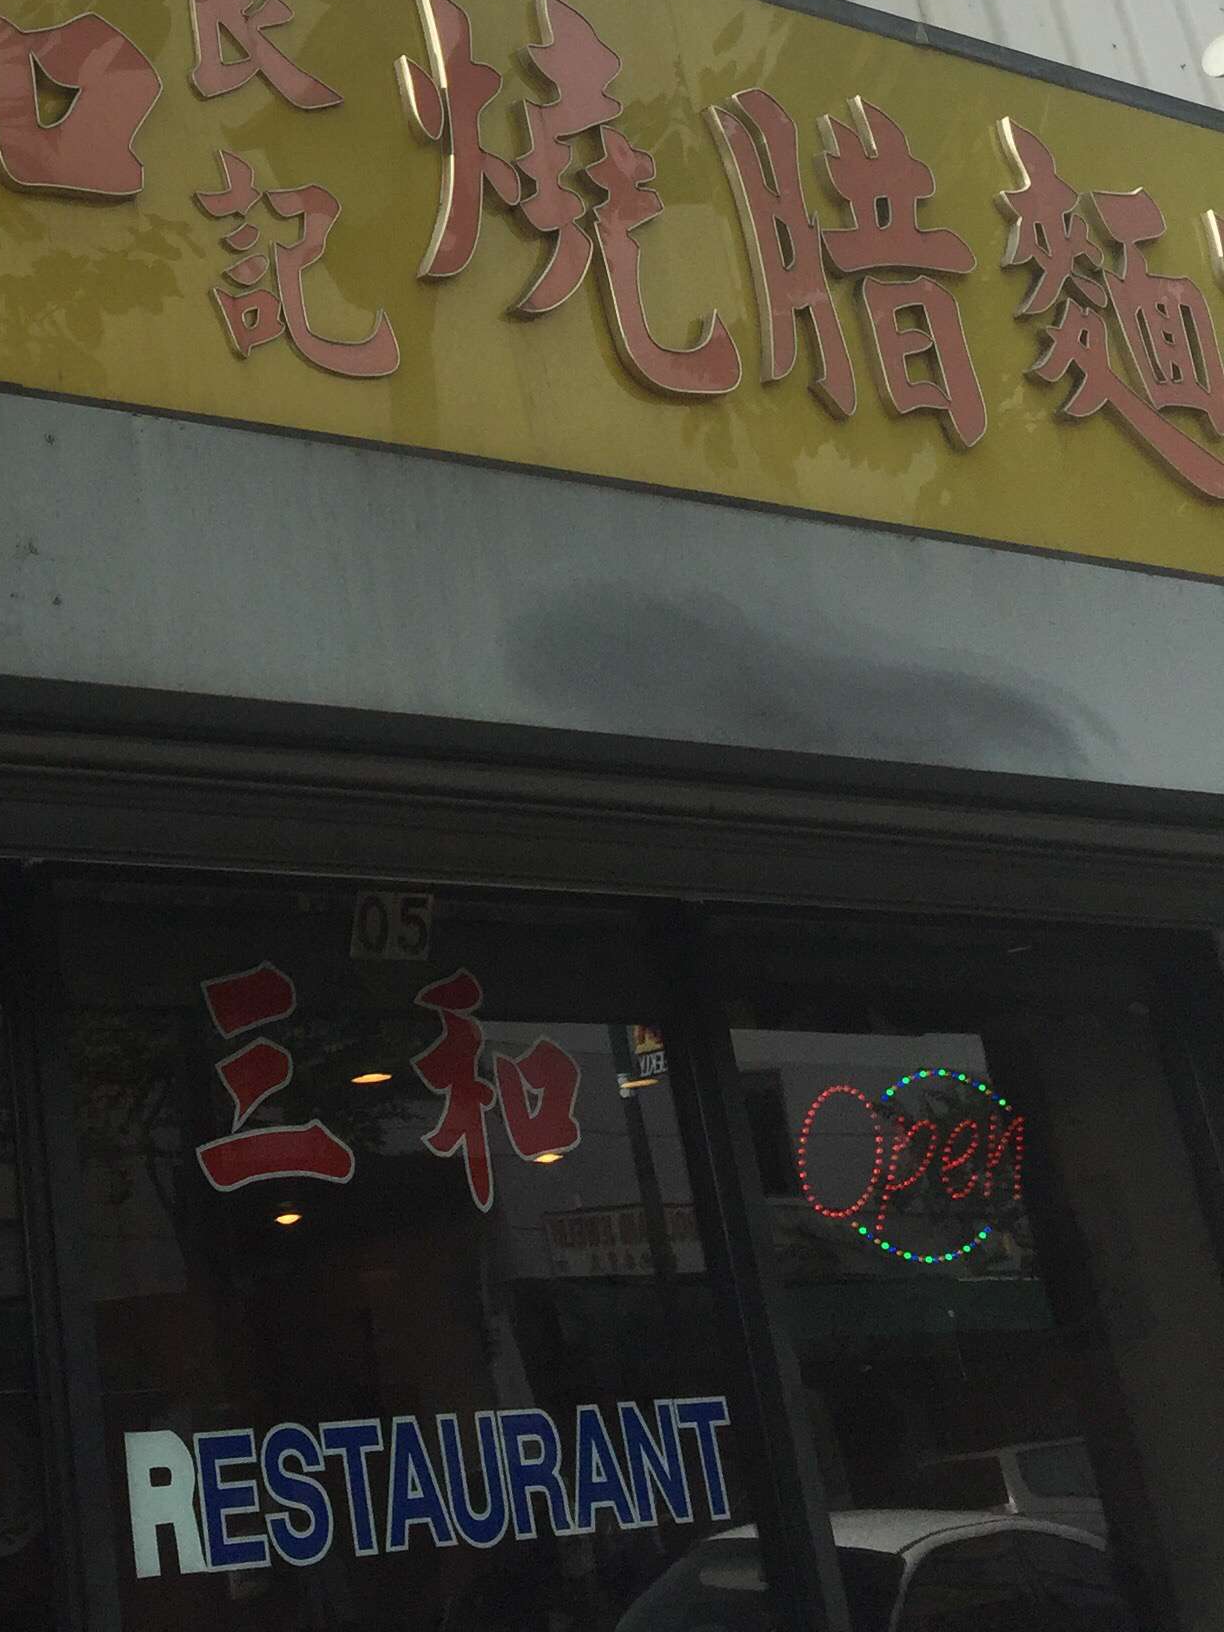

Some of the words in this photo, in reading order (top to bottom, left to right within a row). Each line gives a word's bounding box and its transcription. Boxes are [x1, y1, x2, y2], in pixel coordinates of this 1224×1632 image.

[196, 962, 582, 1213] 三和
[797, 1083, 1027, 1232] Open
[125, 1395, 731, 1579] RESTAURANT
